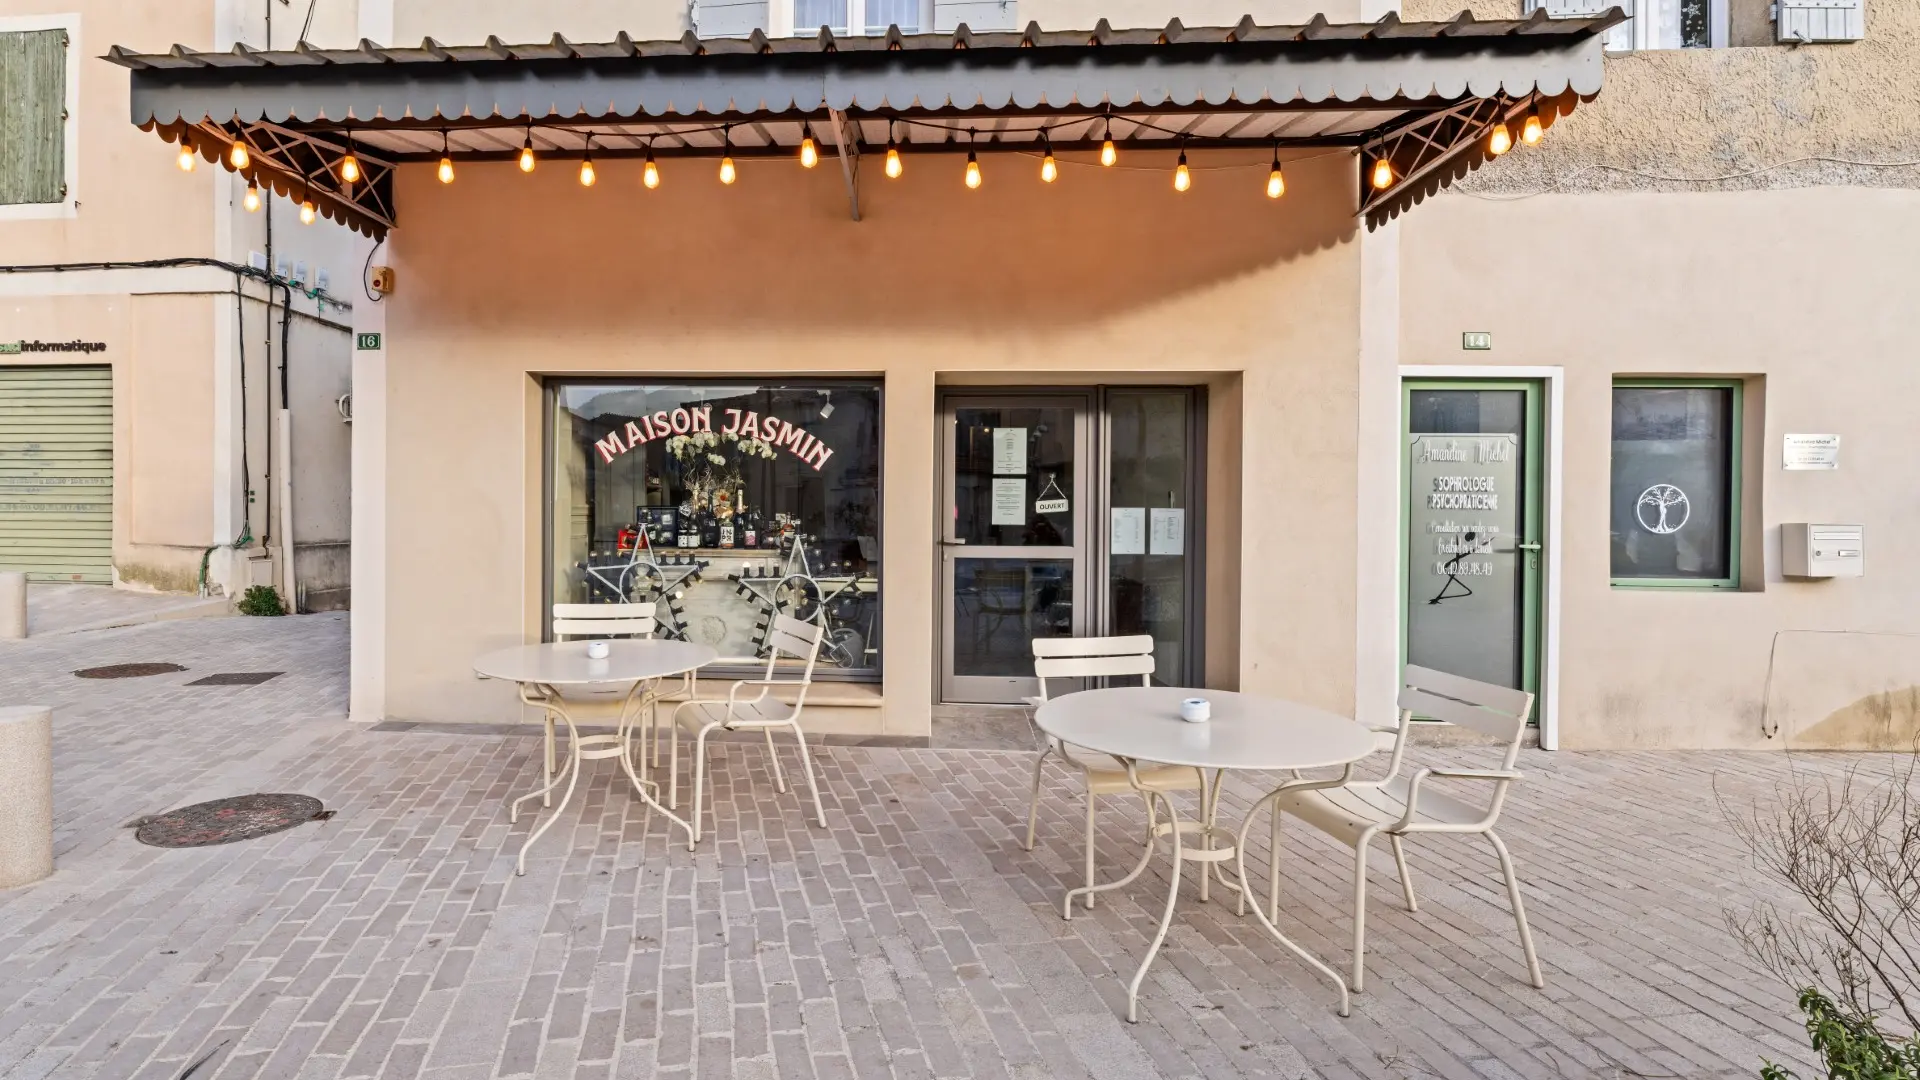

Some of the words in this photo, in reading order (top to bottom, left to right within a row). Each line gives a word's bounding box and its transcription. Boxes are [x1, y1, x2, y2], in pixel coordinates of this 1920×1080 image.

[362, 335, 375, 347] 16
[1470, 335, 1485, 347] 14
[594, 407, 711, 464] MAISON
[721, 408, 834, 471] JASMIN
[1438, 476, 1494, 492] SOPHROLOGUE
